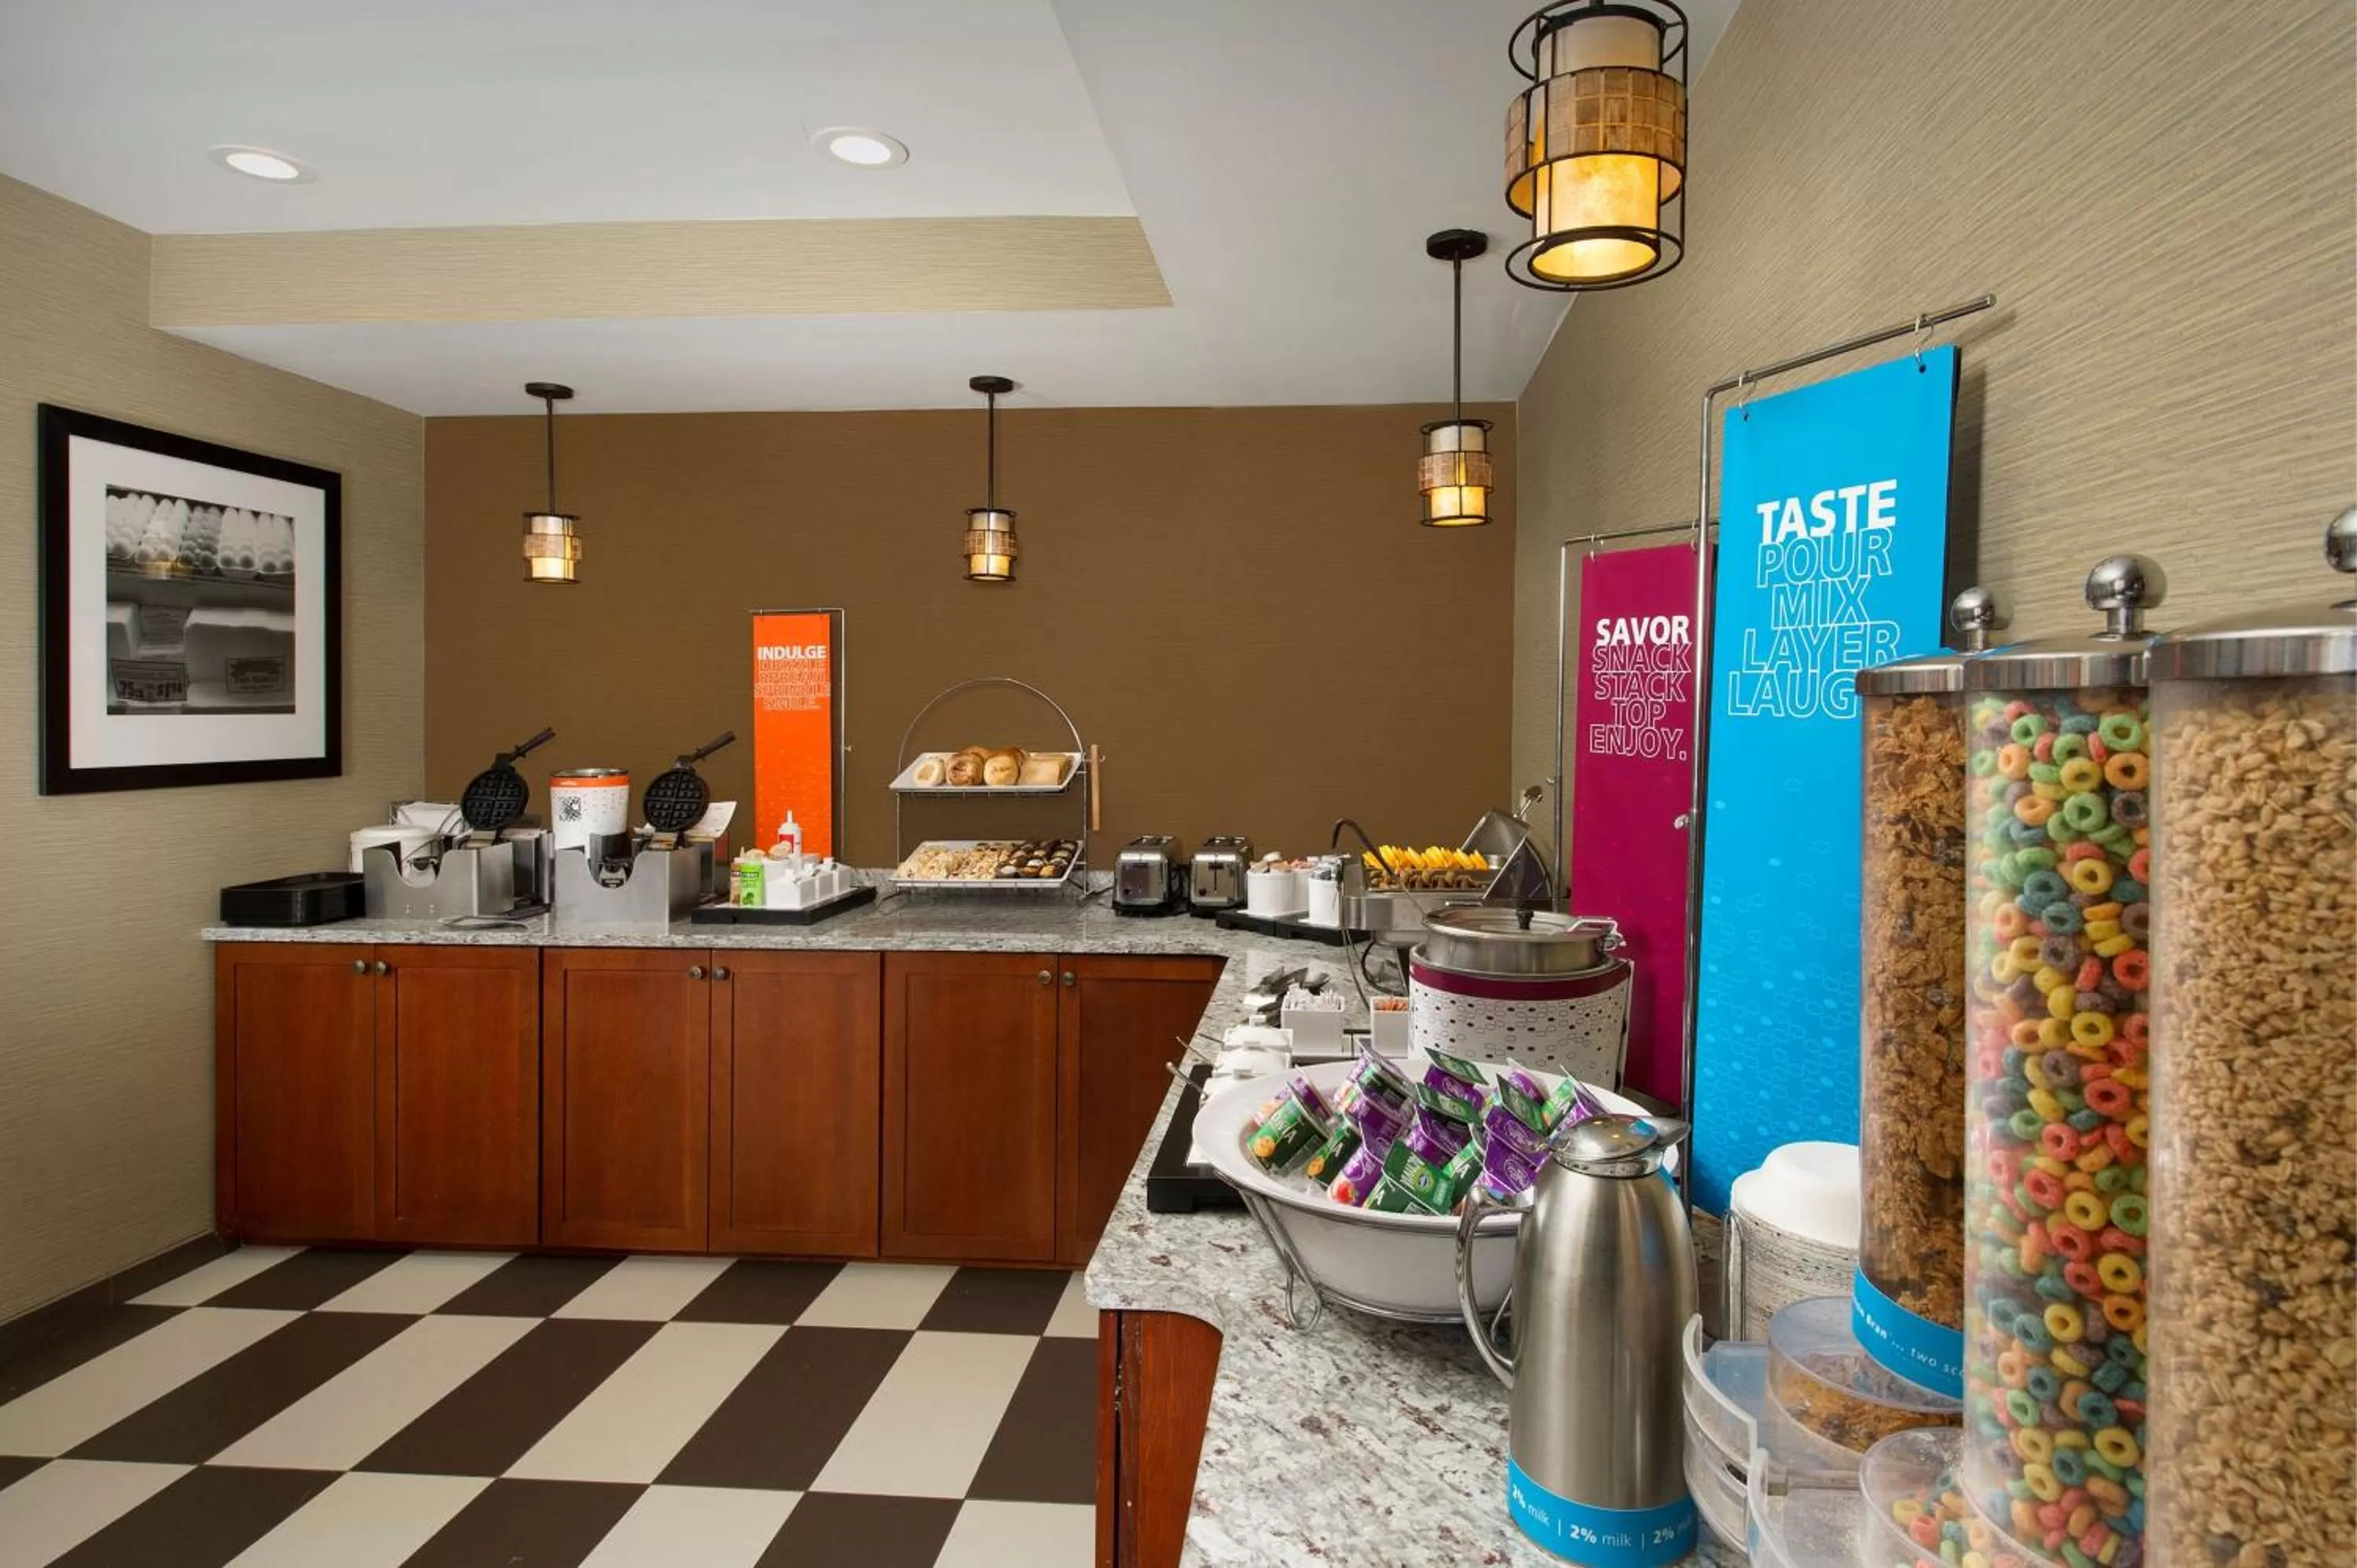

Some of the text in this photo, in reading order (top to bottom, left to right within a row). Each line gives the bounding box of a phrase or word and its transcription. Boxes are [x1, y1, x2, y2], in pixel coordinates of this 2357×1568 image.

[1757, 479, 1897, 545] TASTE
[1757, 527, 1893, 588] POUR
[1772, 577, 1871, 629] MIX
[1596, 615, 1689, 646] SAVOR
[1743, 621, 1901, 673] LAYER
[757, 645, 827, 660] INDULGE
[1593, 642, 1692, 673] SNACK
[1594, 670, 1687, 702] STACK
[1728, 669, 1857, 720] LAUG
[1611, 698, 1666, 727] TOP
[1589, 724, 1688, 761] ENJOY.
[1910, 1347, 1937, 1367] two
[1527, 1504, 1550, 1528] milk
[1571, 1524, 1597, 1544] 2%
[1602, 1533, 1632, 1548] milk
[1653, 1527, 1674, 1544] 2%
